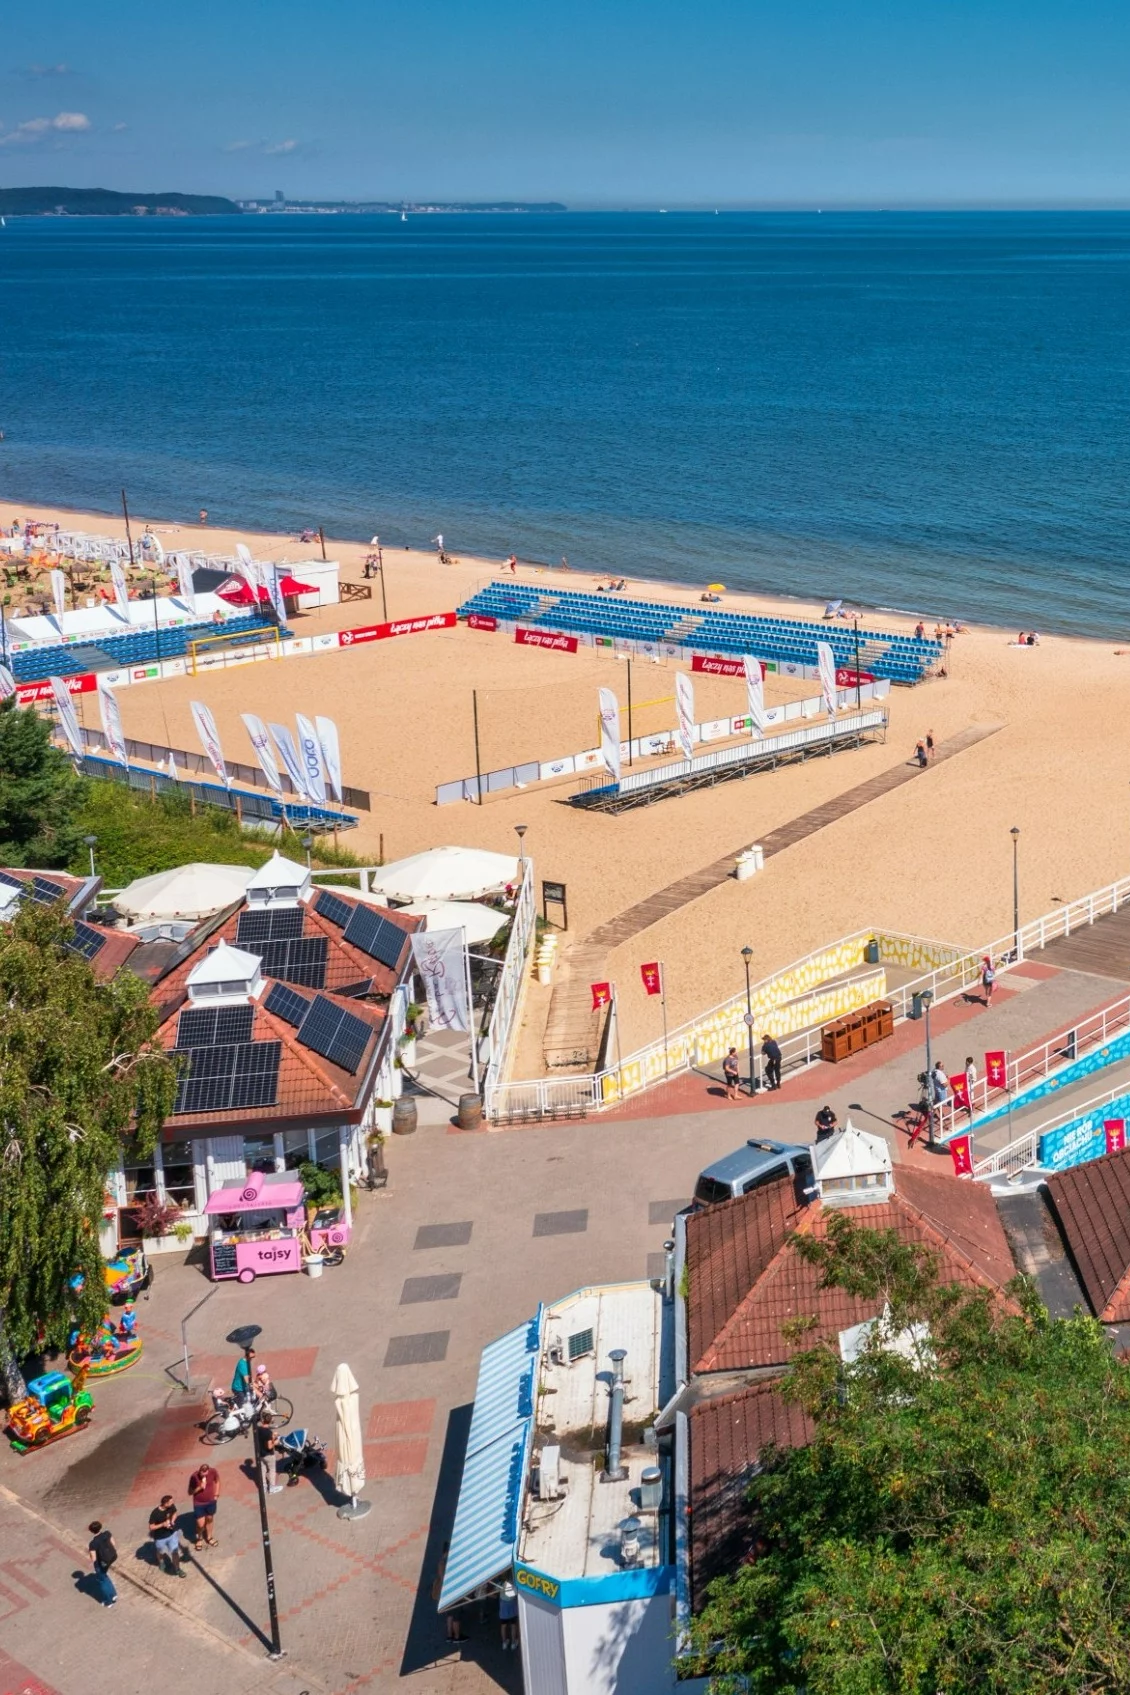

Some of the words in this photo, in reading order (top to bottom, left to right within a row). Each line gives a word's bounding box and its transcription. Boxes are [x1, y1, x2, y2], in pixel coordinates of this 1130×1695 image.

[701, 659, 723, 674] Łączy
[16, 687, 38, 700] ączy
[257, 1247, 291, 1261] tajsy
[516, 1569, 559, 1599] GOFRY
